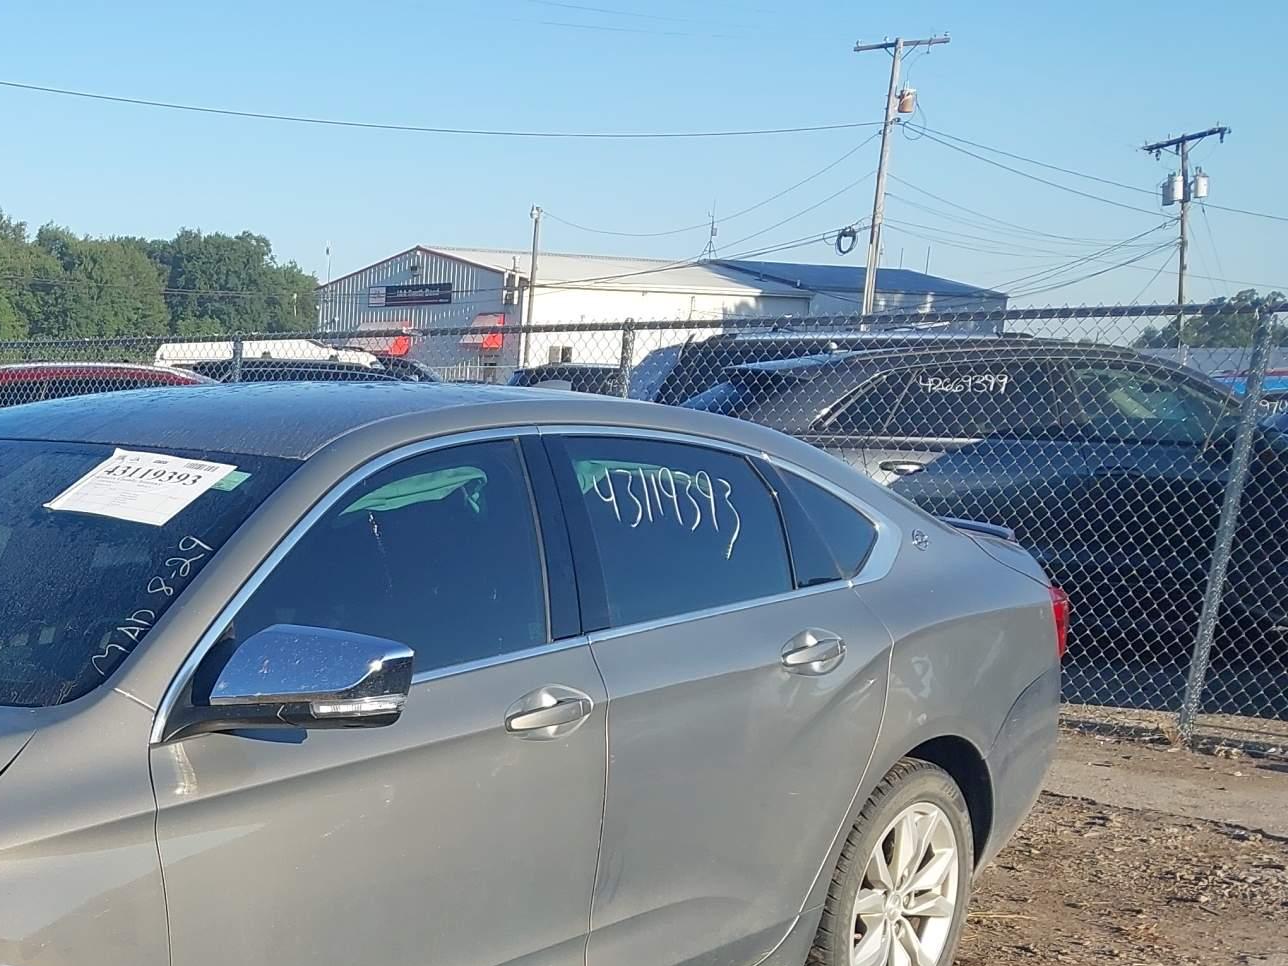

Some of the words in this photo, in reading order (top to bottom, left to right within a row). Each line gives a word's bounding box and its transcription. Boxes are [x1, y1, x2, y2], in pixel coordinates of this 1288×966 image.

[103, 463, 204, 487] 43119393
[592, 465, 742, 561] 43119393
[91, 609, 156, 677] MAD
[147, 534, 215, 597] 8-29
